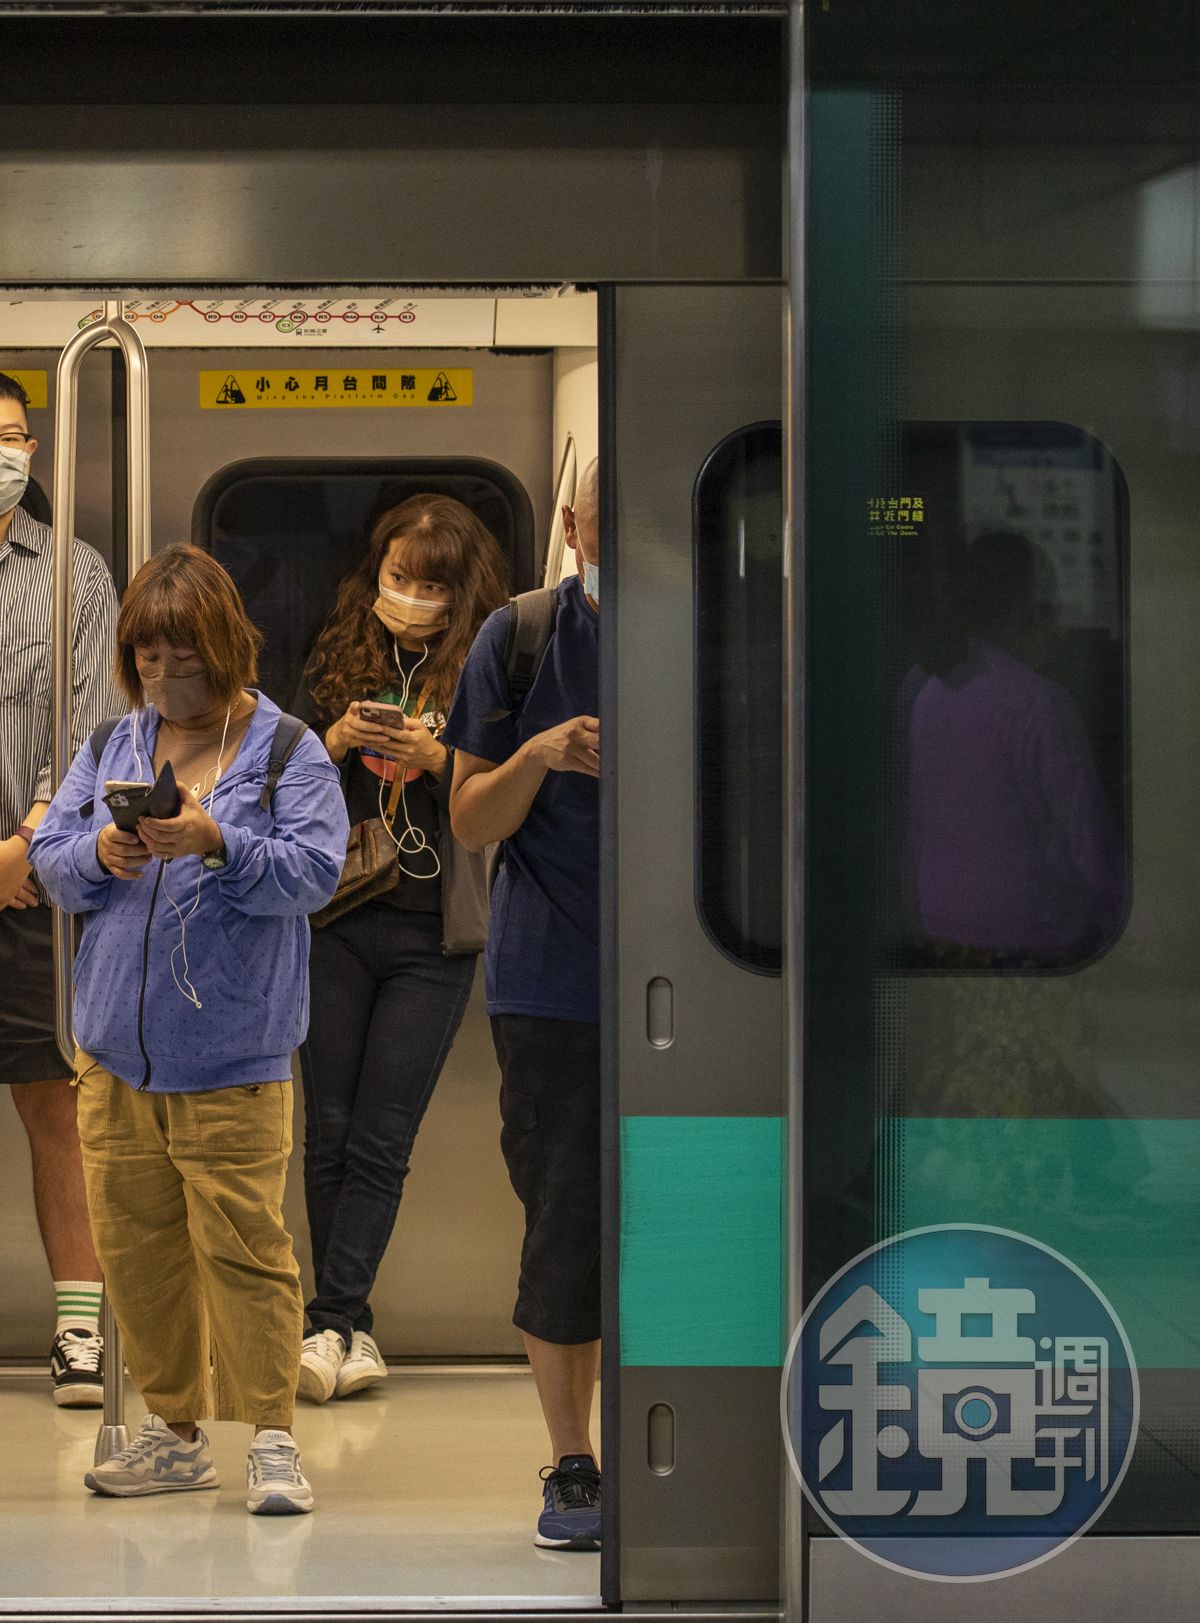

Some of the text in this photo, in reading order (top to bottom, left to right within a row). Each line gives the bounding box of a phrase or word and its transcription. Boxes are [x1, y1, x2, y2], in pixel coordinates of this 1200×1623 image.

[255, 375, 416, 392] 小心月台間隙
